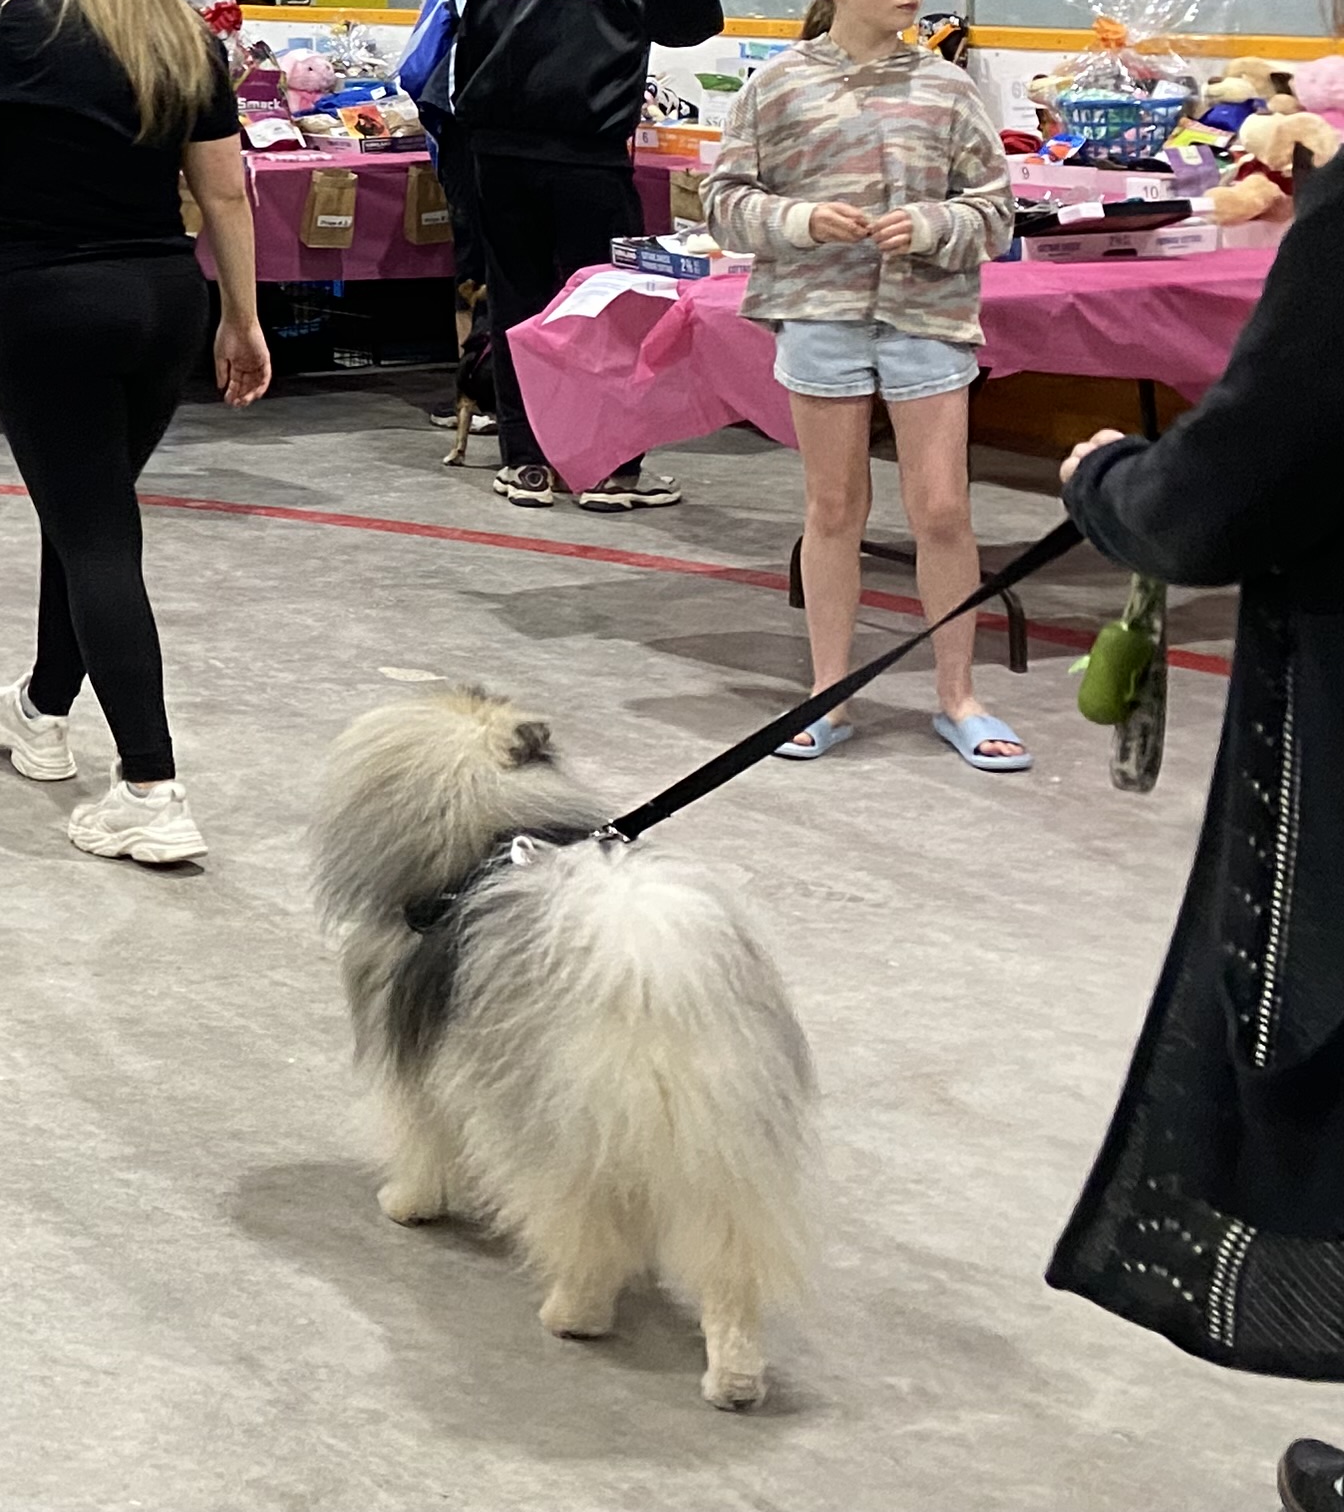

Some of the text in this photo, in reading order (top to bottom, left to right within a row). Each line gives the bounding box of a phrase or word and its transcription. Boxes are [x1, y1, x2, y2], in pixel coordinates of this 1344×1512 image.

[237, 97, 282, 110] Smack
[642, 131, 650, 144] 6
[1021, 166, 1030, 180] 9
[1143, 184, 1160, 200] 10
